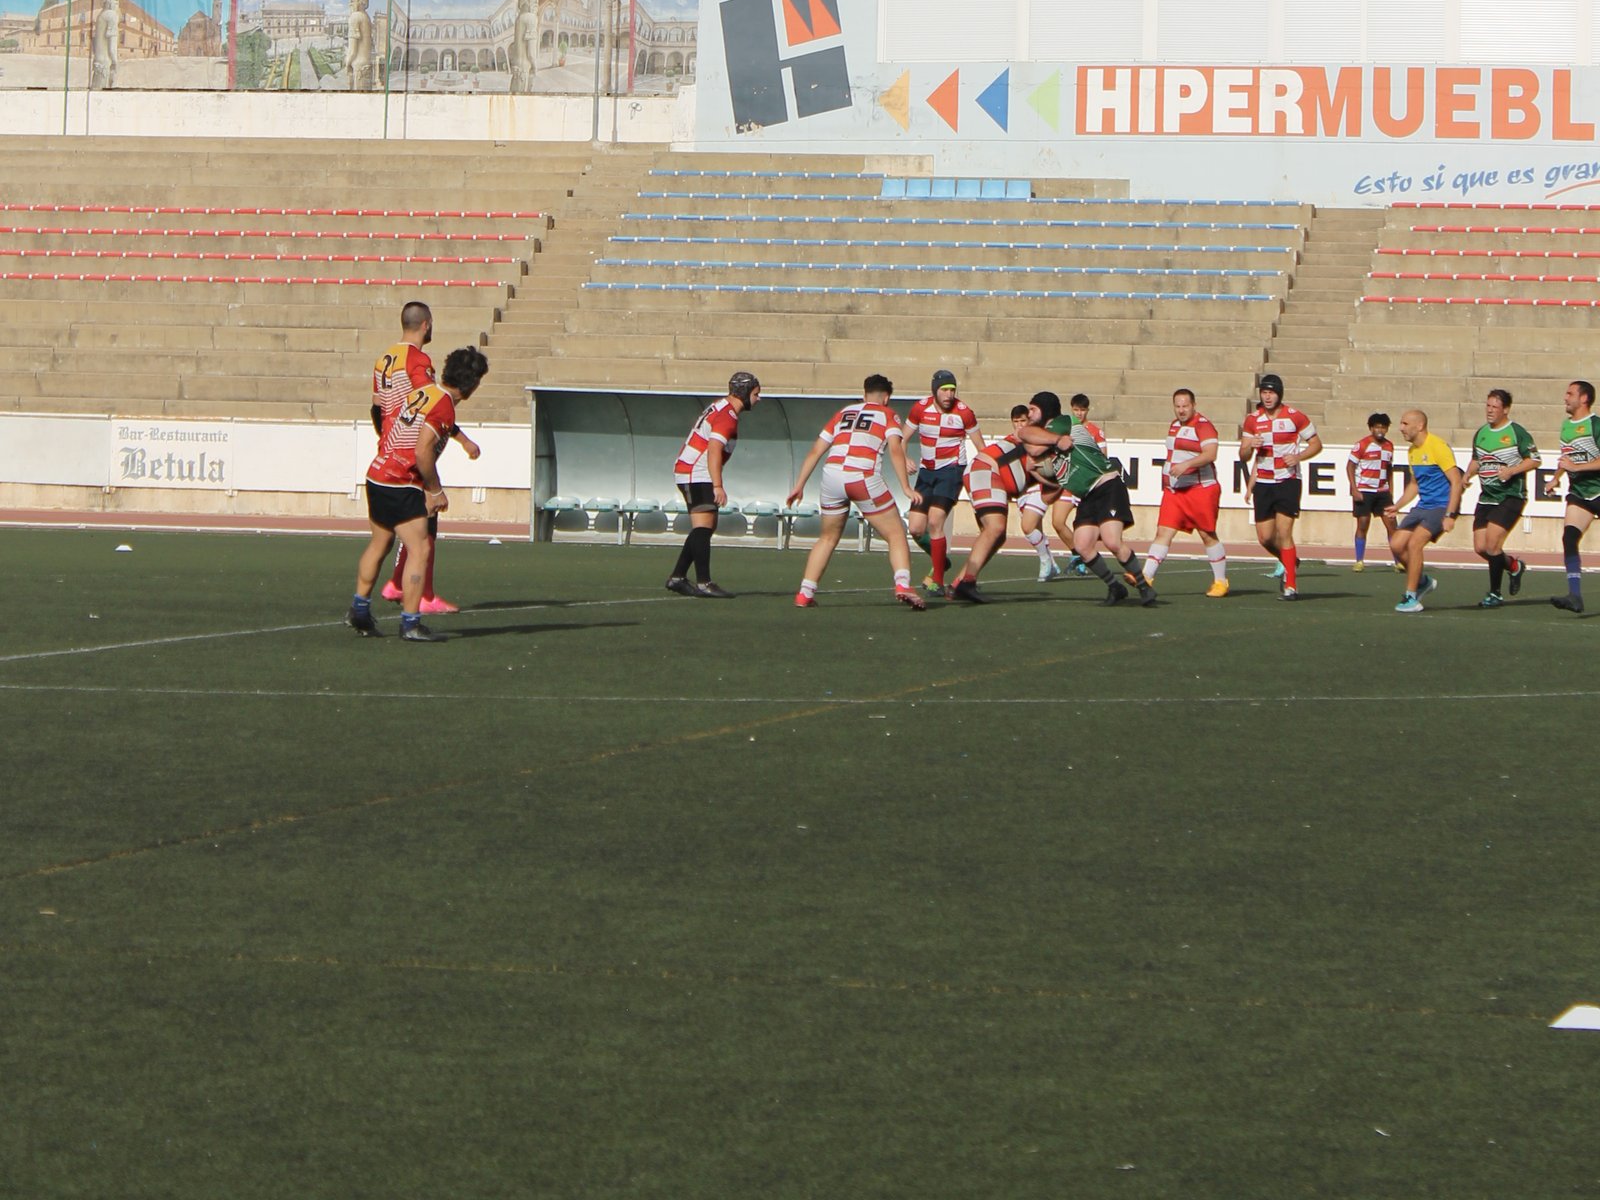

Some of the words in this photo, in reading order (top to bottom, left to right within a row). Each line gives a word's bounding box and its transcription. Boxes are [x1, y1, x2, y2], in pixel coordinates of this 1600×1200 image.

[1085, 67, 1596, 141] HIPERMUEBL
[1353, 171, 1412, 194] Esto
[1421, 163, 1446, 191] si
[1452, 170, 1499, 197] que
[1507, 166, 1535, 184] es
[119, 426, 228, 443] Bar-Restaurante
[839, 413, 875, 431] 56
[120, 446, 225, 483] Betula
